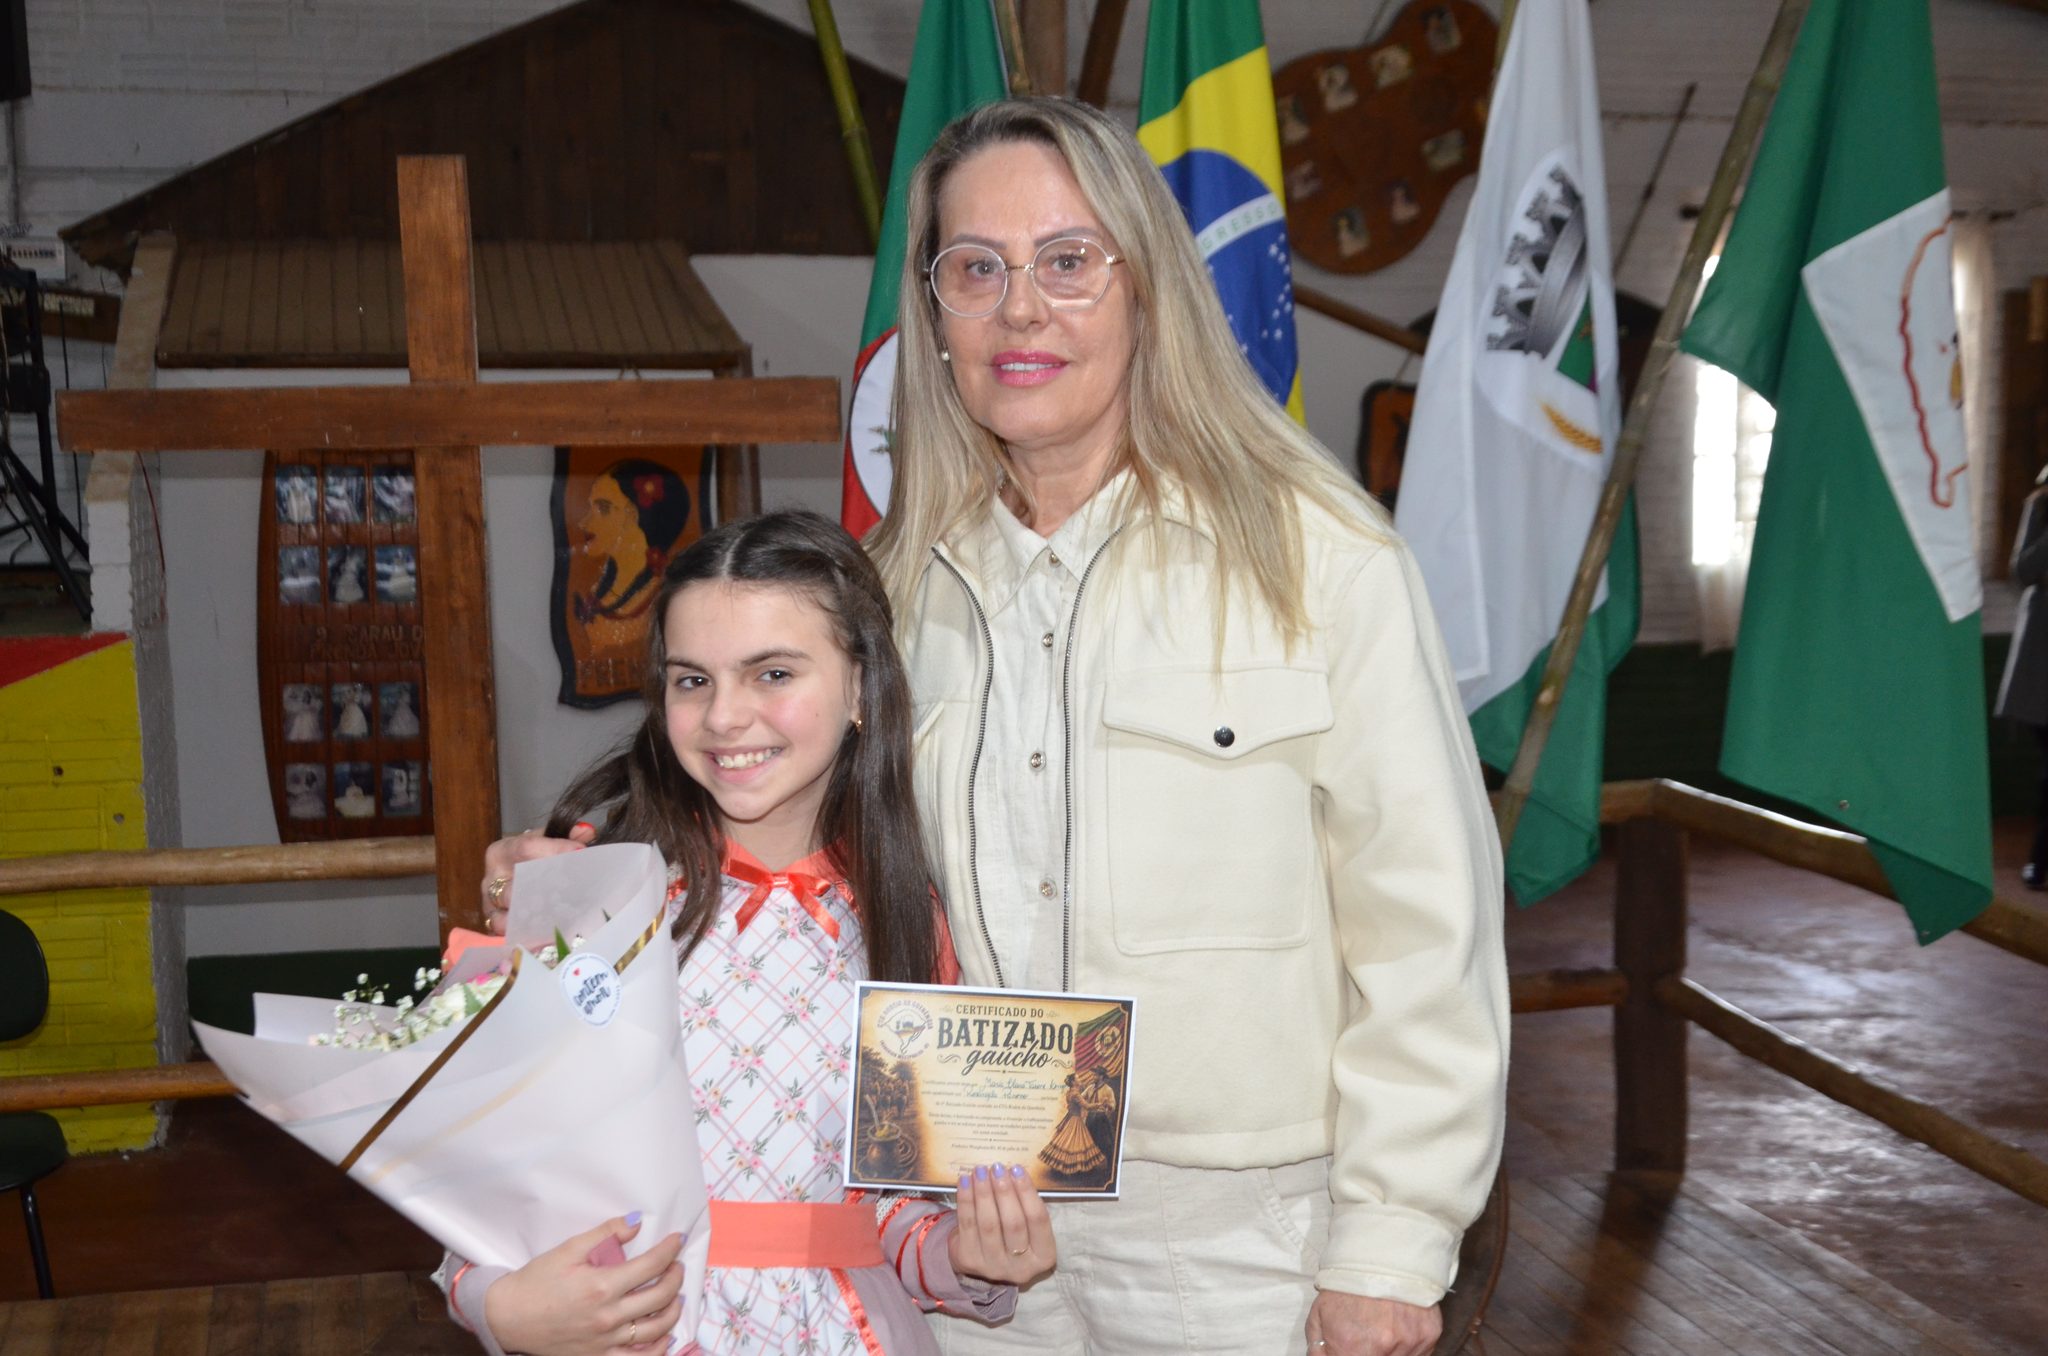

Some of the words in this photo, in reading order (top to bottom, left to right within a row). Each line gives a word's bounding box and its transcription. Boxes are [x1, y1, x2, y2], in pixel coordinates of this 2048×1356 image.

[1202, 201, 1278, 250] GRESSO
[955, 1004, 1027, 1018] CERTIFICADO
[1030, 1008, 1045, 1018] DO
[937, 1017, 1073, 1055] BATIZADO
[961, 1040, 1053, 1076] gaúcho
